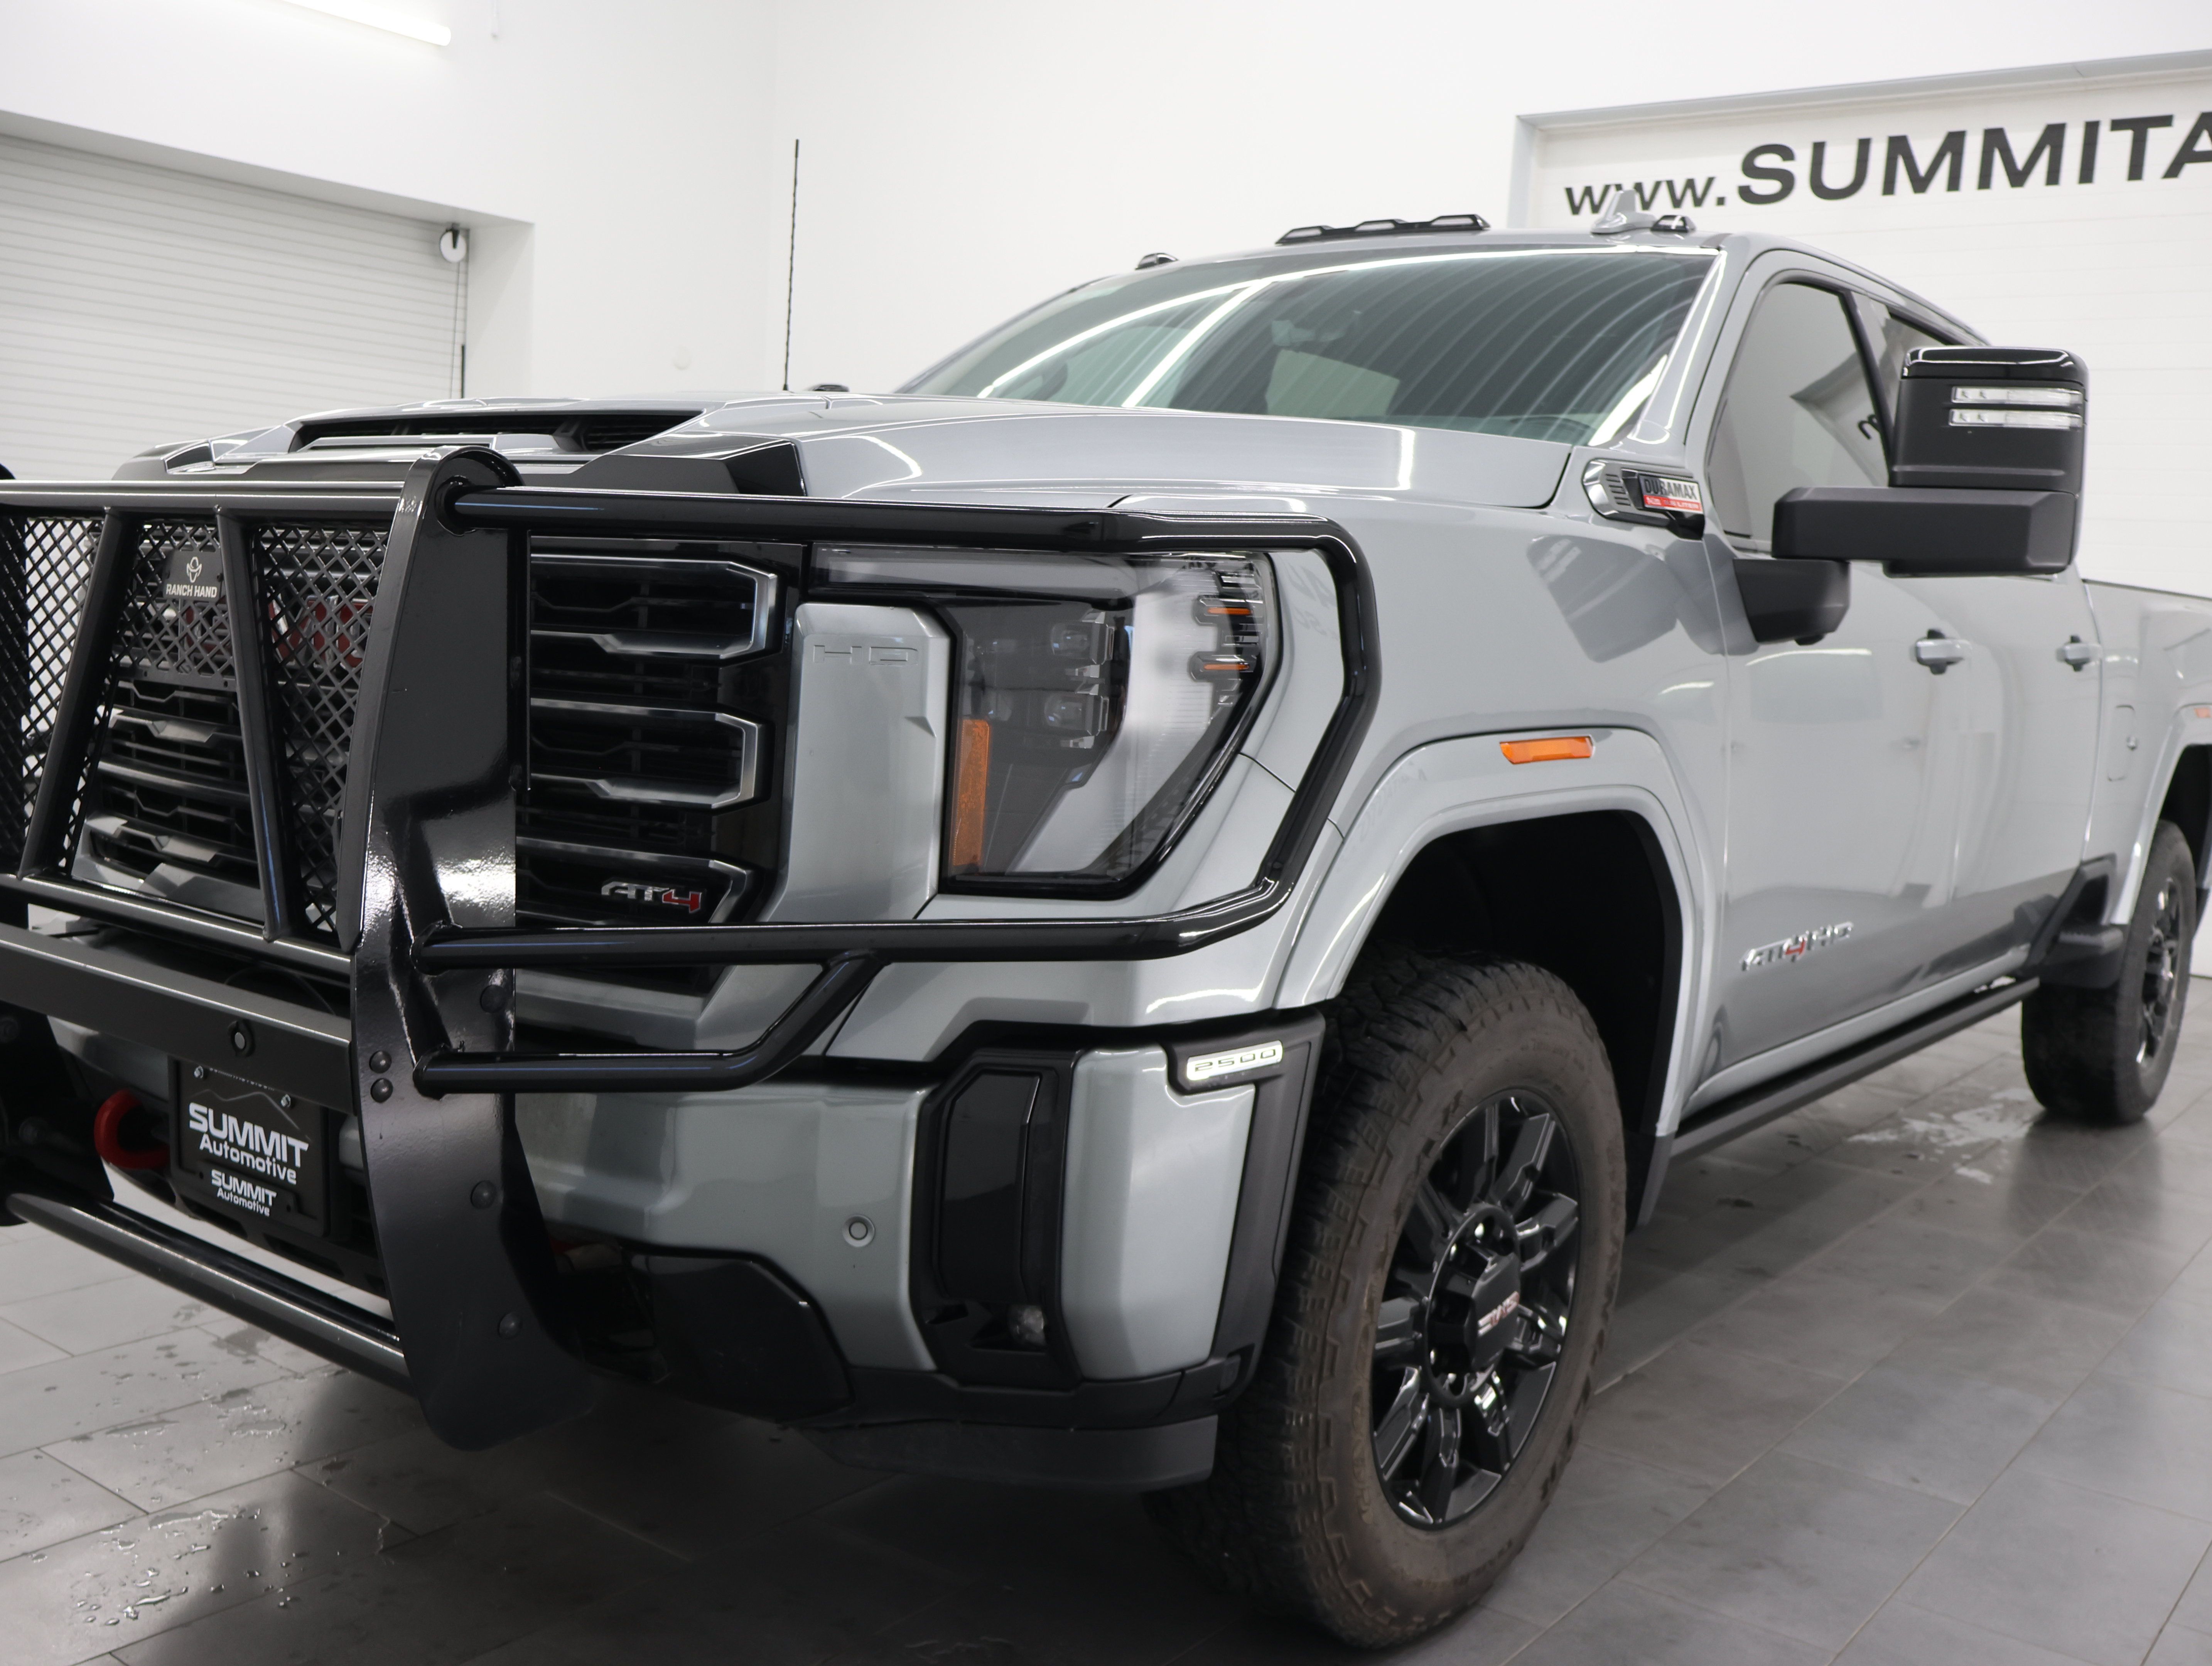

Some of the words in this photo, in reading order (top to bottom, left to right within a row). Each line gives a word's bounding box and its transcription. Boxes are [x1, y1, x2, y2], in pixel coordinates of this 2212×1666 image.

[1644, 478, 1698, 500] DURAMAX
[165, 583, 193, 597] RANCH
[194, 585, 218, 598] HAND
[813, 645, 918, 665] HD
[601, 881, 702, 914] AT4
[1195, 1048, 1276, 1072] 2500
[189, 1102, 309, 1168] SUMMIT
[199, 1133, 297, 1185] Automotive
[211, 1169, 277, 1207] SUMMIT
[217, 1187, 270, 1217] Automotive
